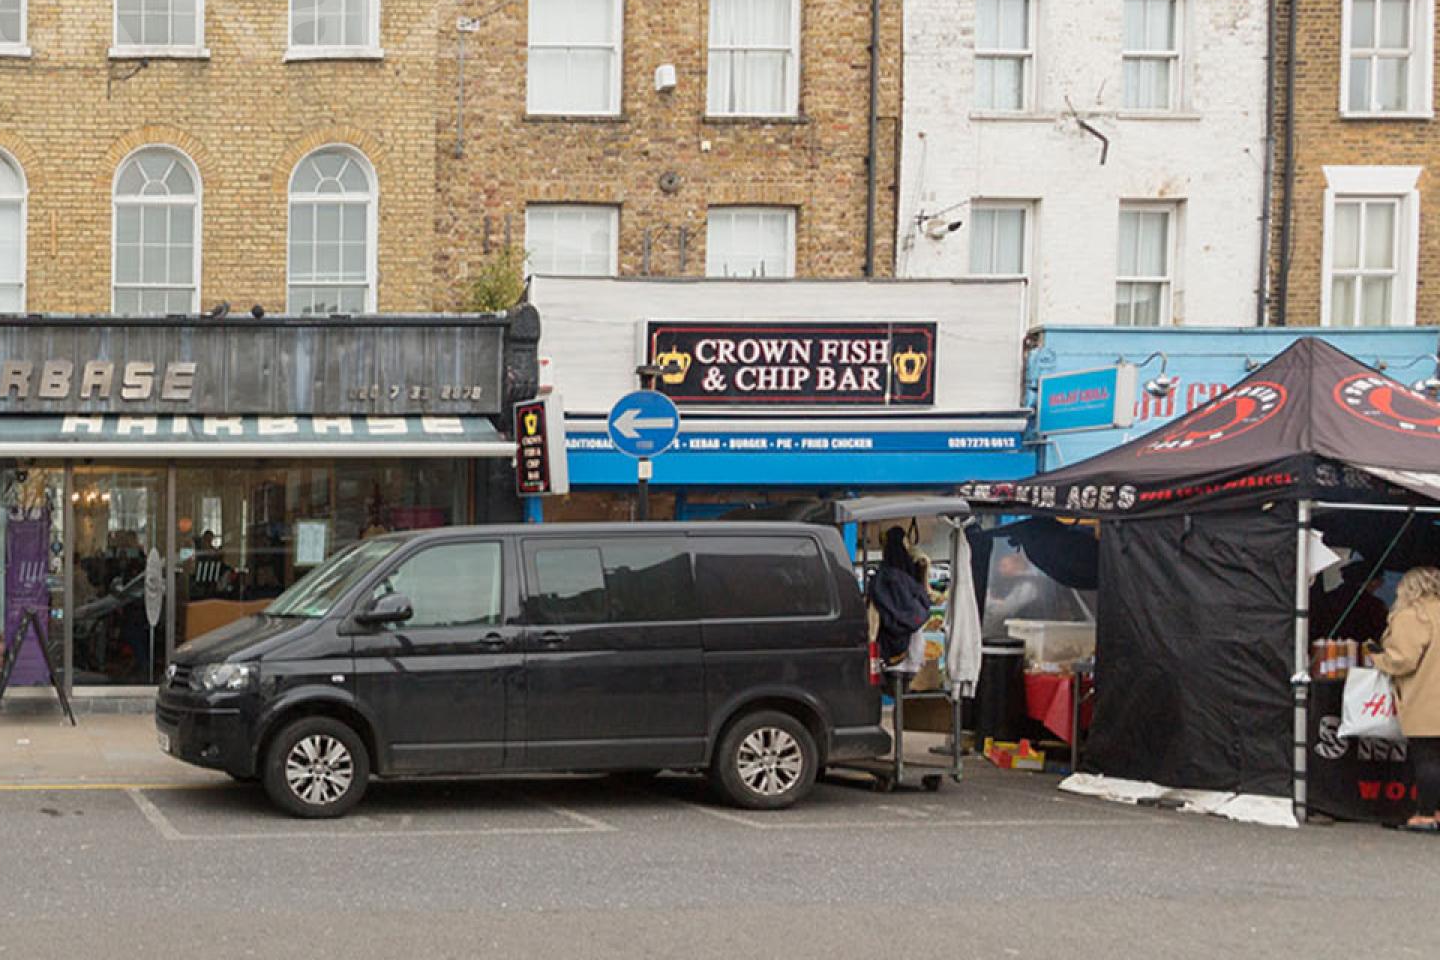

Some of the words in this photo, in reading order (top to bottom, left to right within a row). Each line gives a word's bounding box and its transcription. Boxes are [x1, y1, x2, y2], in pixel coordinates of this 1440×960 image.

[695, 338, 813, 365] CROWN
[819, 338, 890, 364] FISH
[702, 366, 728, 391] &
[734, 366, 811, 391] CHIP
[815, 366, 883, 391] BAR
[1065, 484, 1137, 511] ACES
